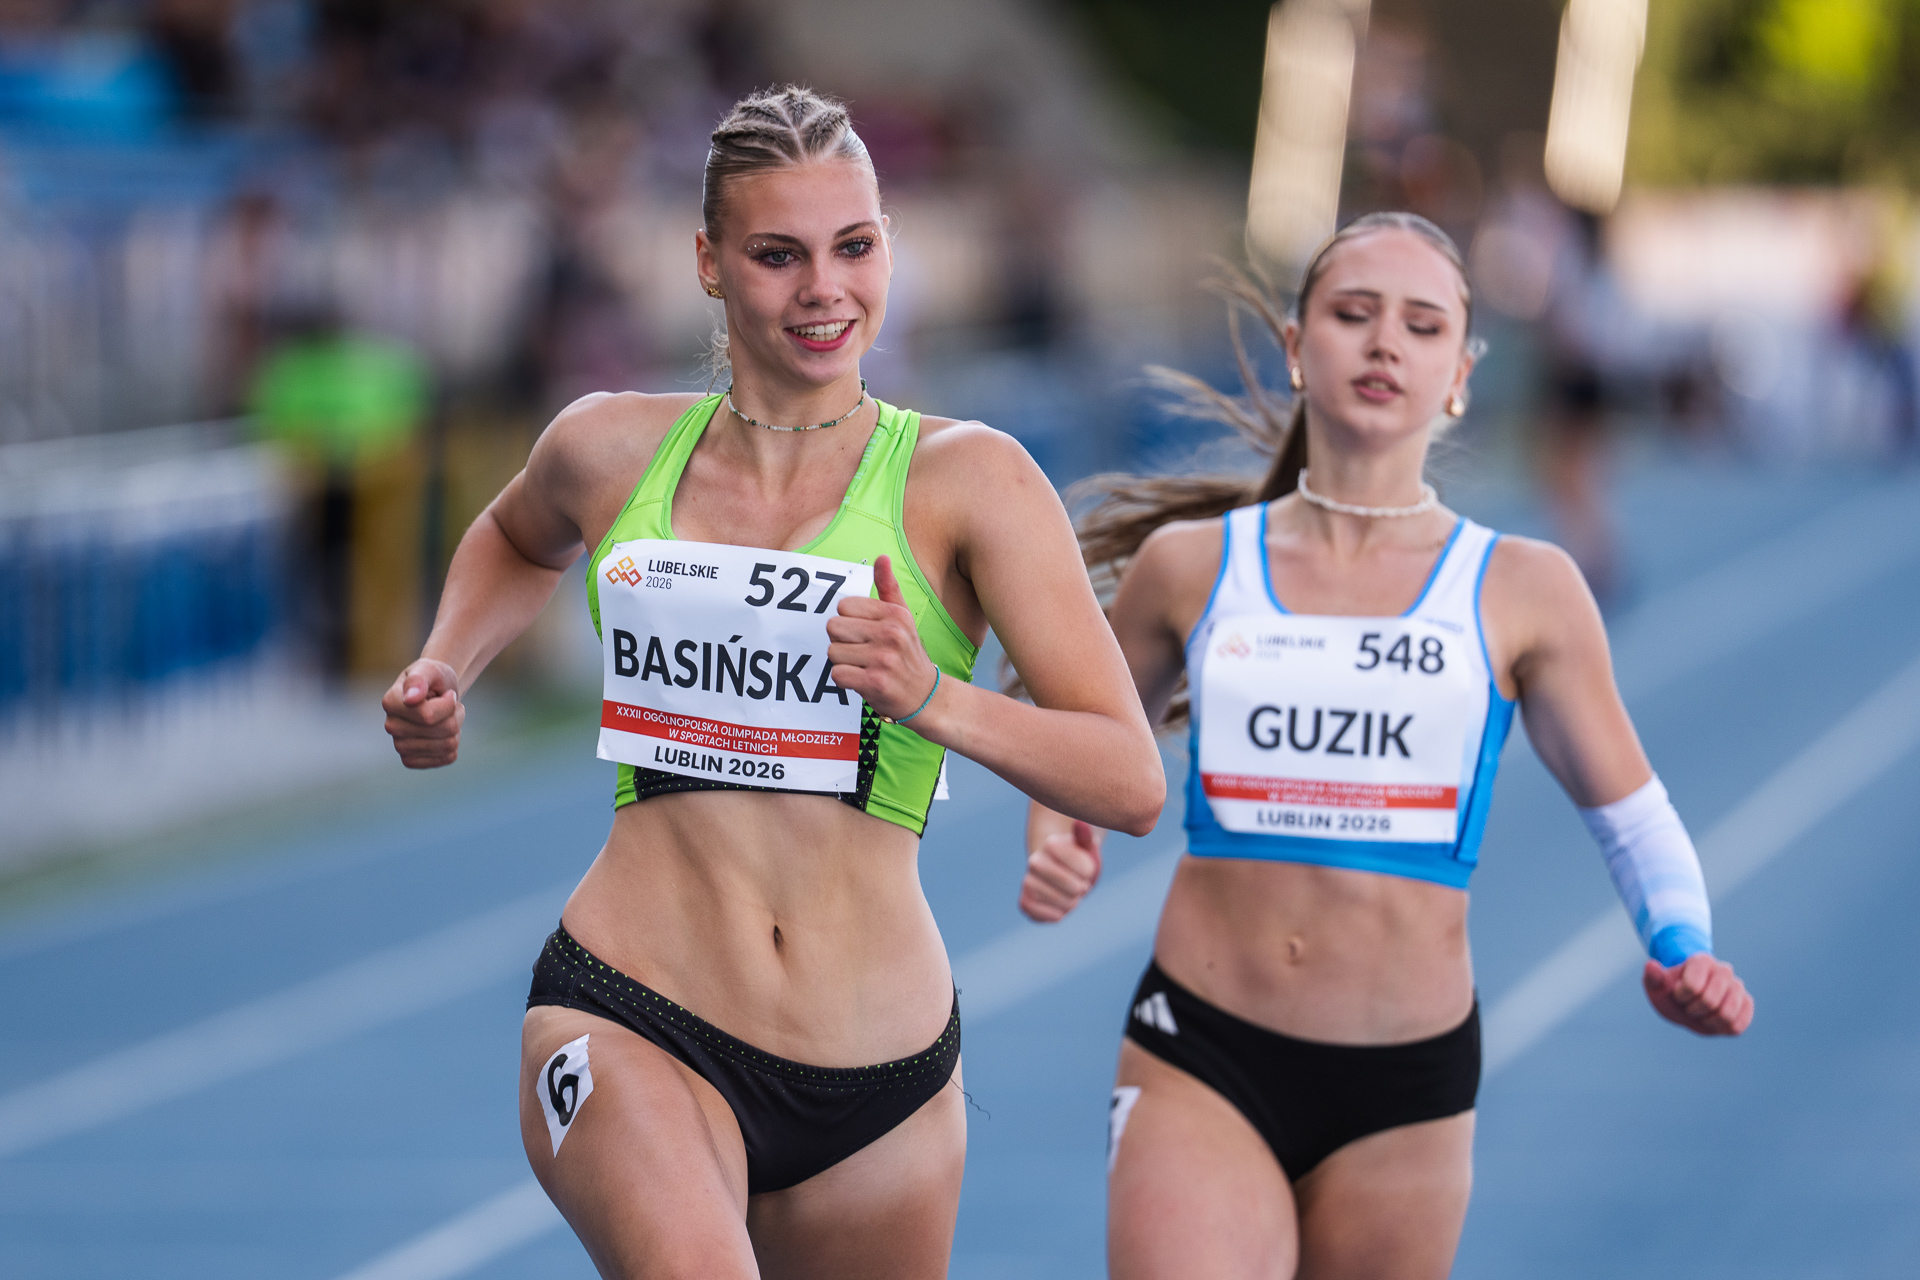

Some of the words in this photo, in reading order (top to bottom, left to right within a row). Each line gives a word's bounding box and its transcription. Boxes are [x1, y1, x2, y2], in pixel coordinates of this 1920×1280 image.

[645, 575, 673, 590] 2026
[647, 559, 720, 580] LUBELSKIE
[744, 562, 847, 615] 527
[612, 628, 850, 706] BASIŃSKA
[1355, 632, 1446, 675] 548
[616, 705, 641, 720] XXXII
[643, 710, 720, 735] OGÓLNOPOLSKA
[720, 725, 778, 742] OLIMPIADA
[781, 731, 844, 746] MŁODZIEŻY
[668, 728, 679, 739] W
[679, 730, 731, 749] SPORTACH
[732, 740, 778, 754] LETNICH
[1248, 704, 1415, 759] GUZIK
[654, 745, 724, 774] LUBLIN
[728, 758, 786, 780] 2026
[1257, 808, 1332, 831] LUBLIN
[1339, 814, 1392, 832] 2026
[547, 1053, 580, 1127] 6
